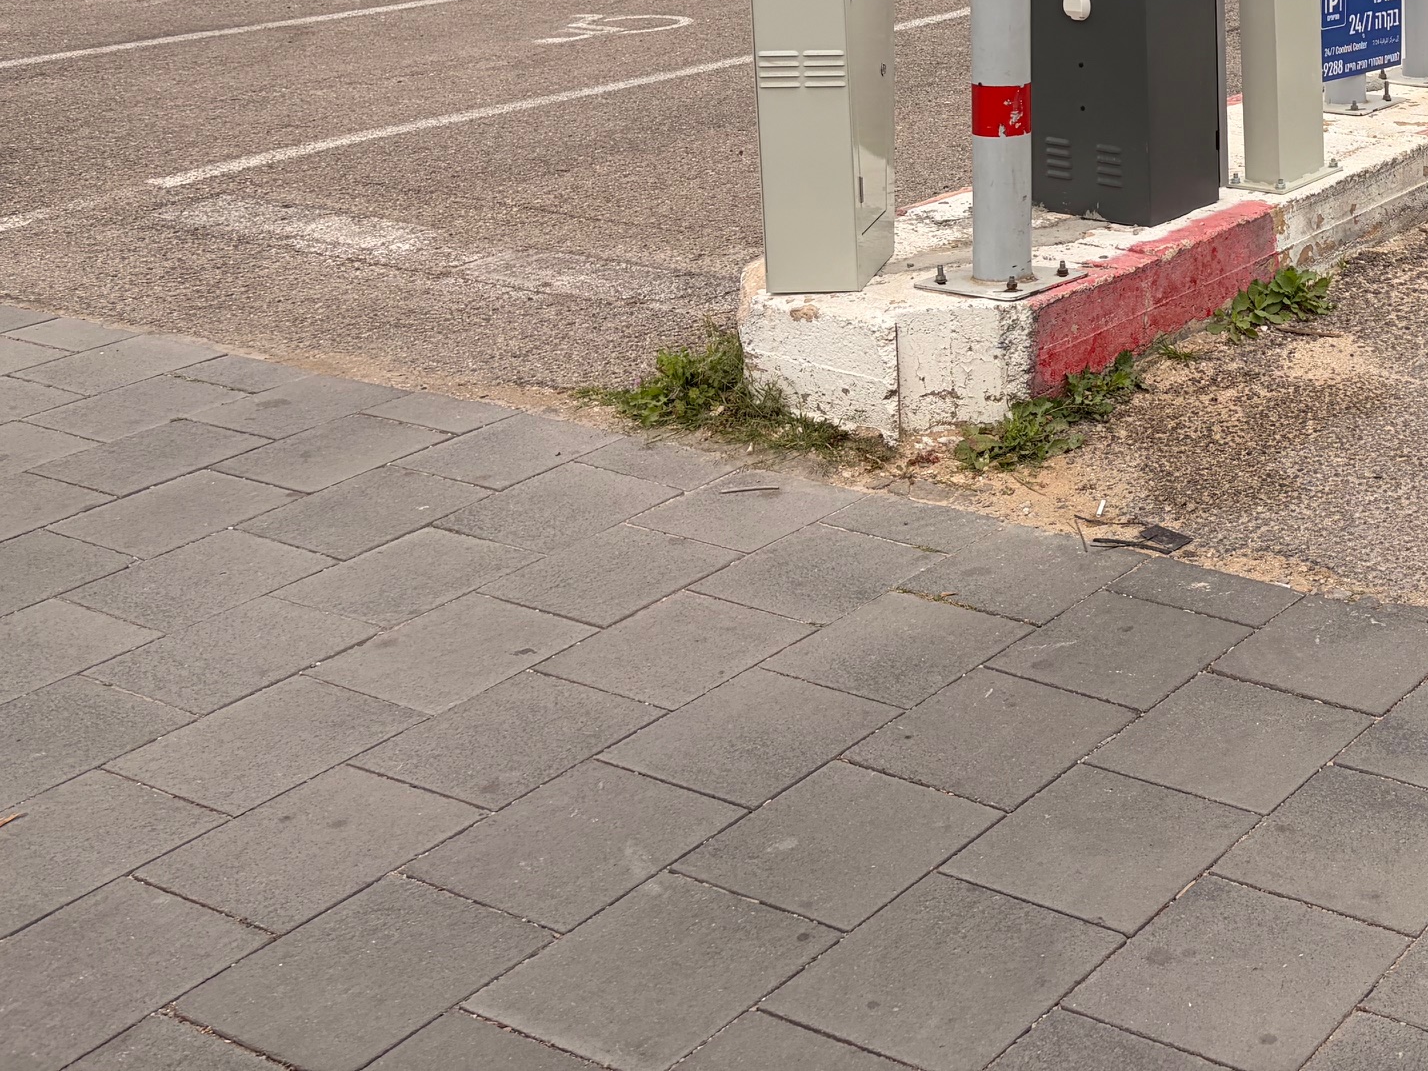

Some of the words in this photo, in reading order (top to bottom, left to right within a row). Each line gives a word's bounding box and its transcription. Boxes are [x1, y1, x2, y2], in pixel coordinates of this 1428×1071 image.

[1349, 11, 1372, 35] 24/7
[1375, 9, 1400, 30] בקרה
[1322, 60, 1344, 77] 9288
